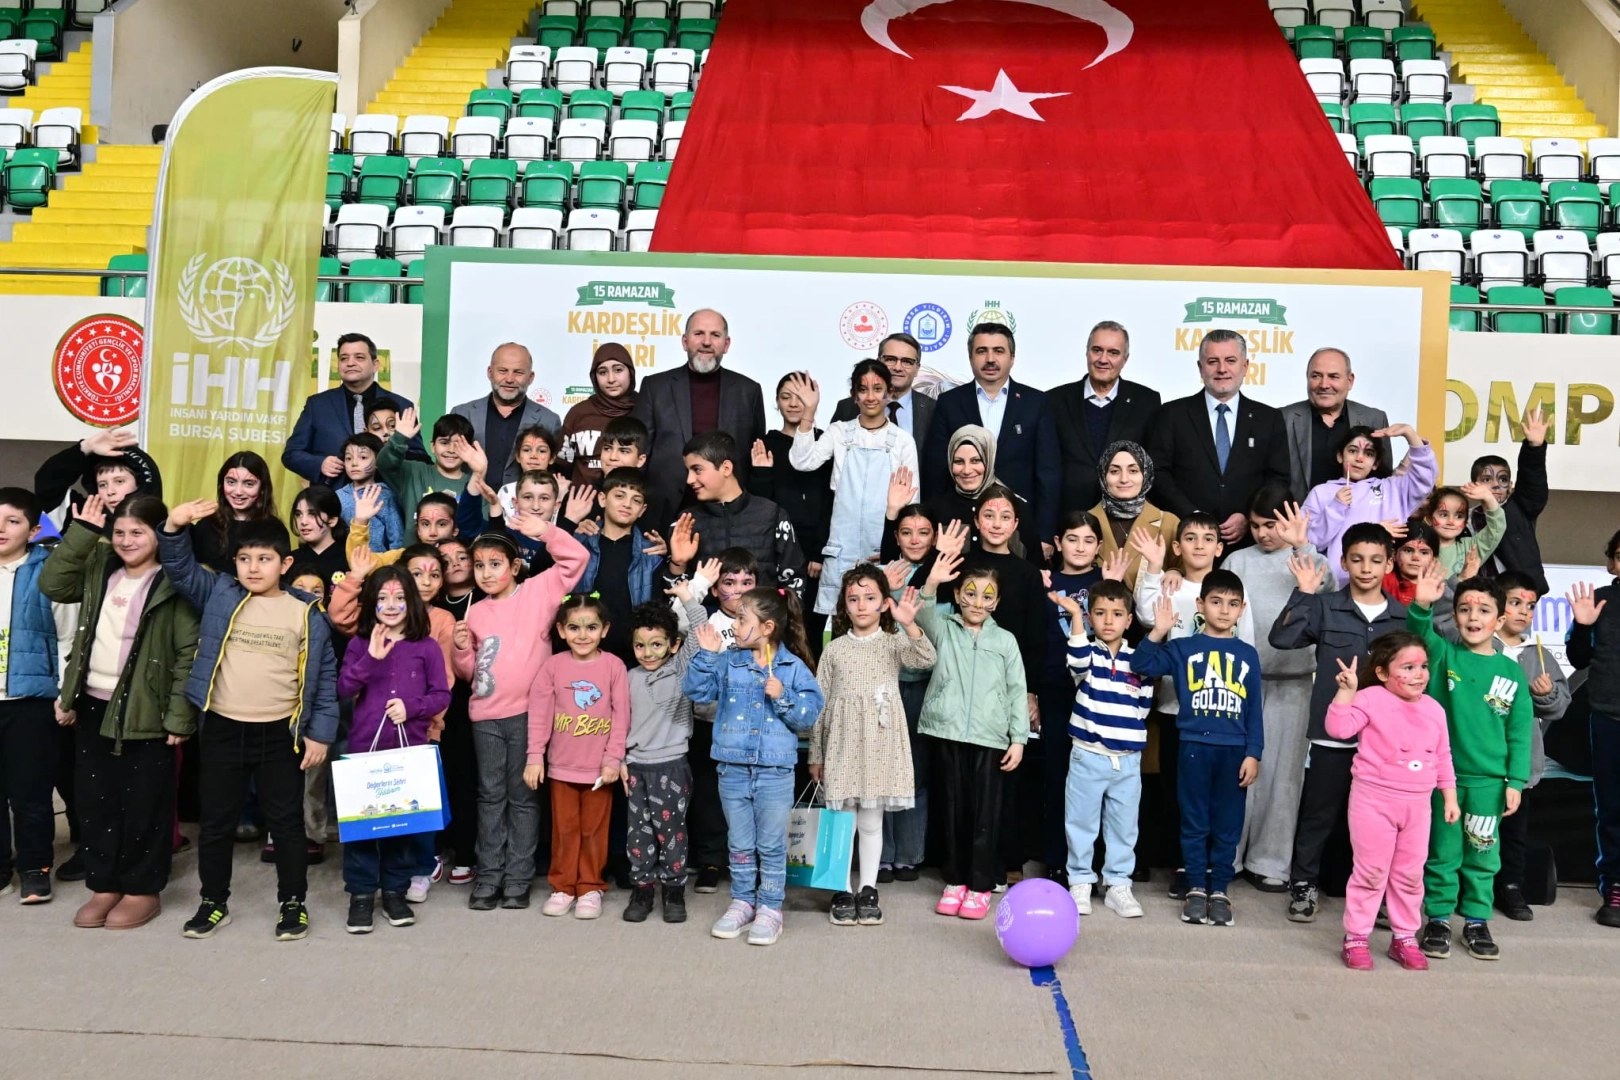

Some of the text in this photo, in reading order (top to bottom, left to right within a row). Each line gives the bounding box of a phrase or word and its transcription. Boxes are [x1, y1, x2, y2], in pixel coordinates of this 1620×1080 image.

[593, 285, 659, 298] 15 RAMAZAN
[1202, 301, 1270, 315] 15 RAMAZAN
[567, 309, 683, 342] KARDEŞLİK
[98, 338, 126, 349] GENÇLİK
[130, 354, 139, 372] SPOR
[210, 410, 253, 423] YARDIM
[1444, 379, 1615, 445] OMP
[169, 423, 287, 444] BURSA ŞUBESİ
[1191, 688, 1242, 713] GOLDEN
[555, 713, 611, 737] MR BEAS
[1194, 709, 1240, 720] STATE
